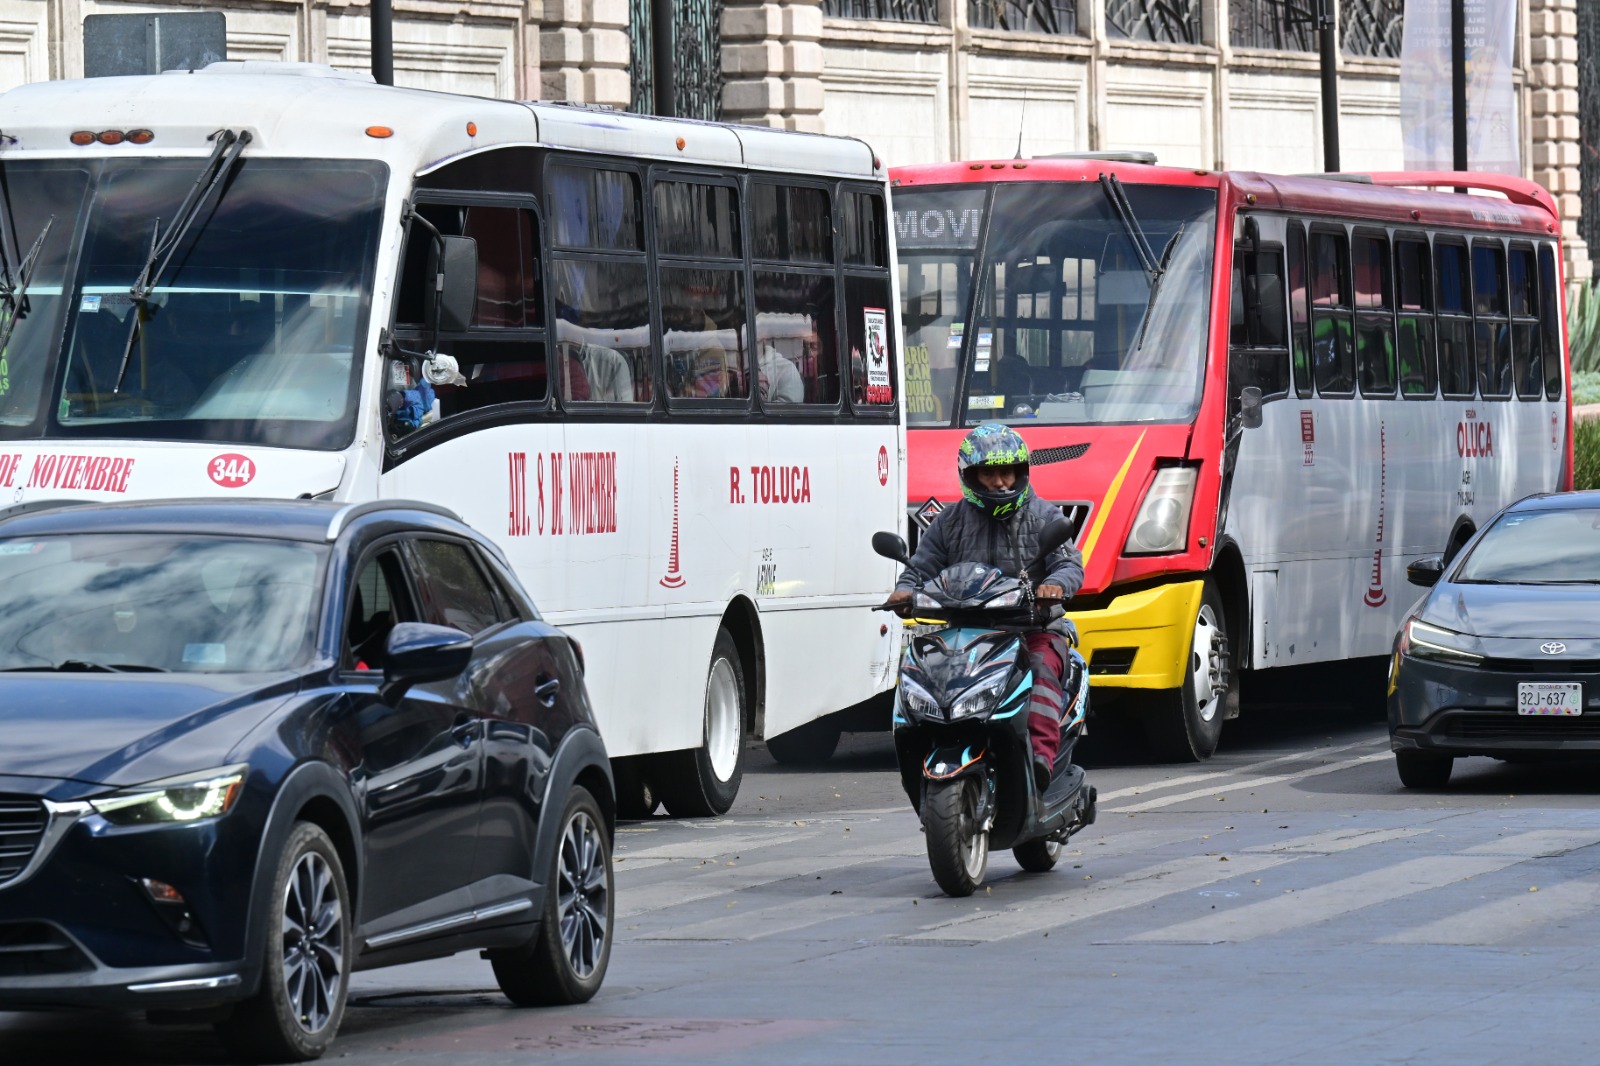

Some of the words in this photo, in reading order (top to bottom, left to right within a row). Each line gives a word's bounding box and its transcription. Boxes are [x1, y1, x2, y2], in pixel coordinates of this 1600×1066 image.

[26, 454, 135, 493] NOVIEMBRE
[212, 457, 251, 483] 344
[730, 466, 746, 504] R.
[751, 465, 811, 504] TOLUCA
[537, 452, 545, 536] 8
[550, 452, 564, 536] DE
[568, 451, 618, 536] NOVIEMBRE
[1520, 691, 1566, 706] 32J-637
